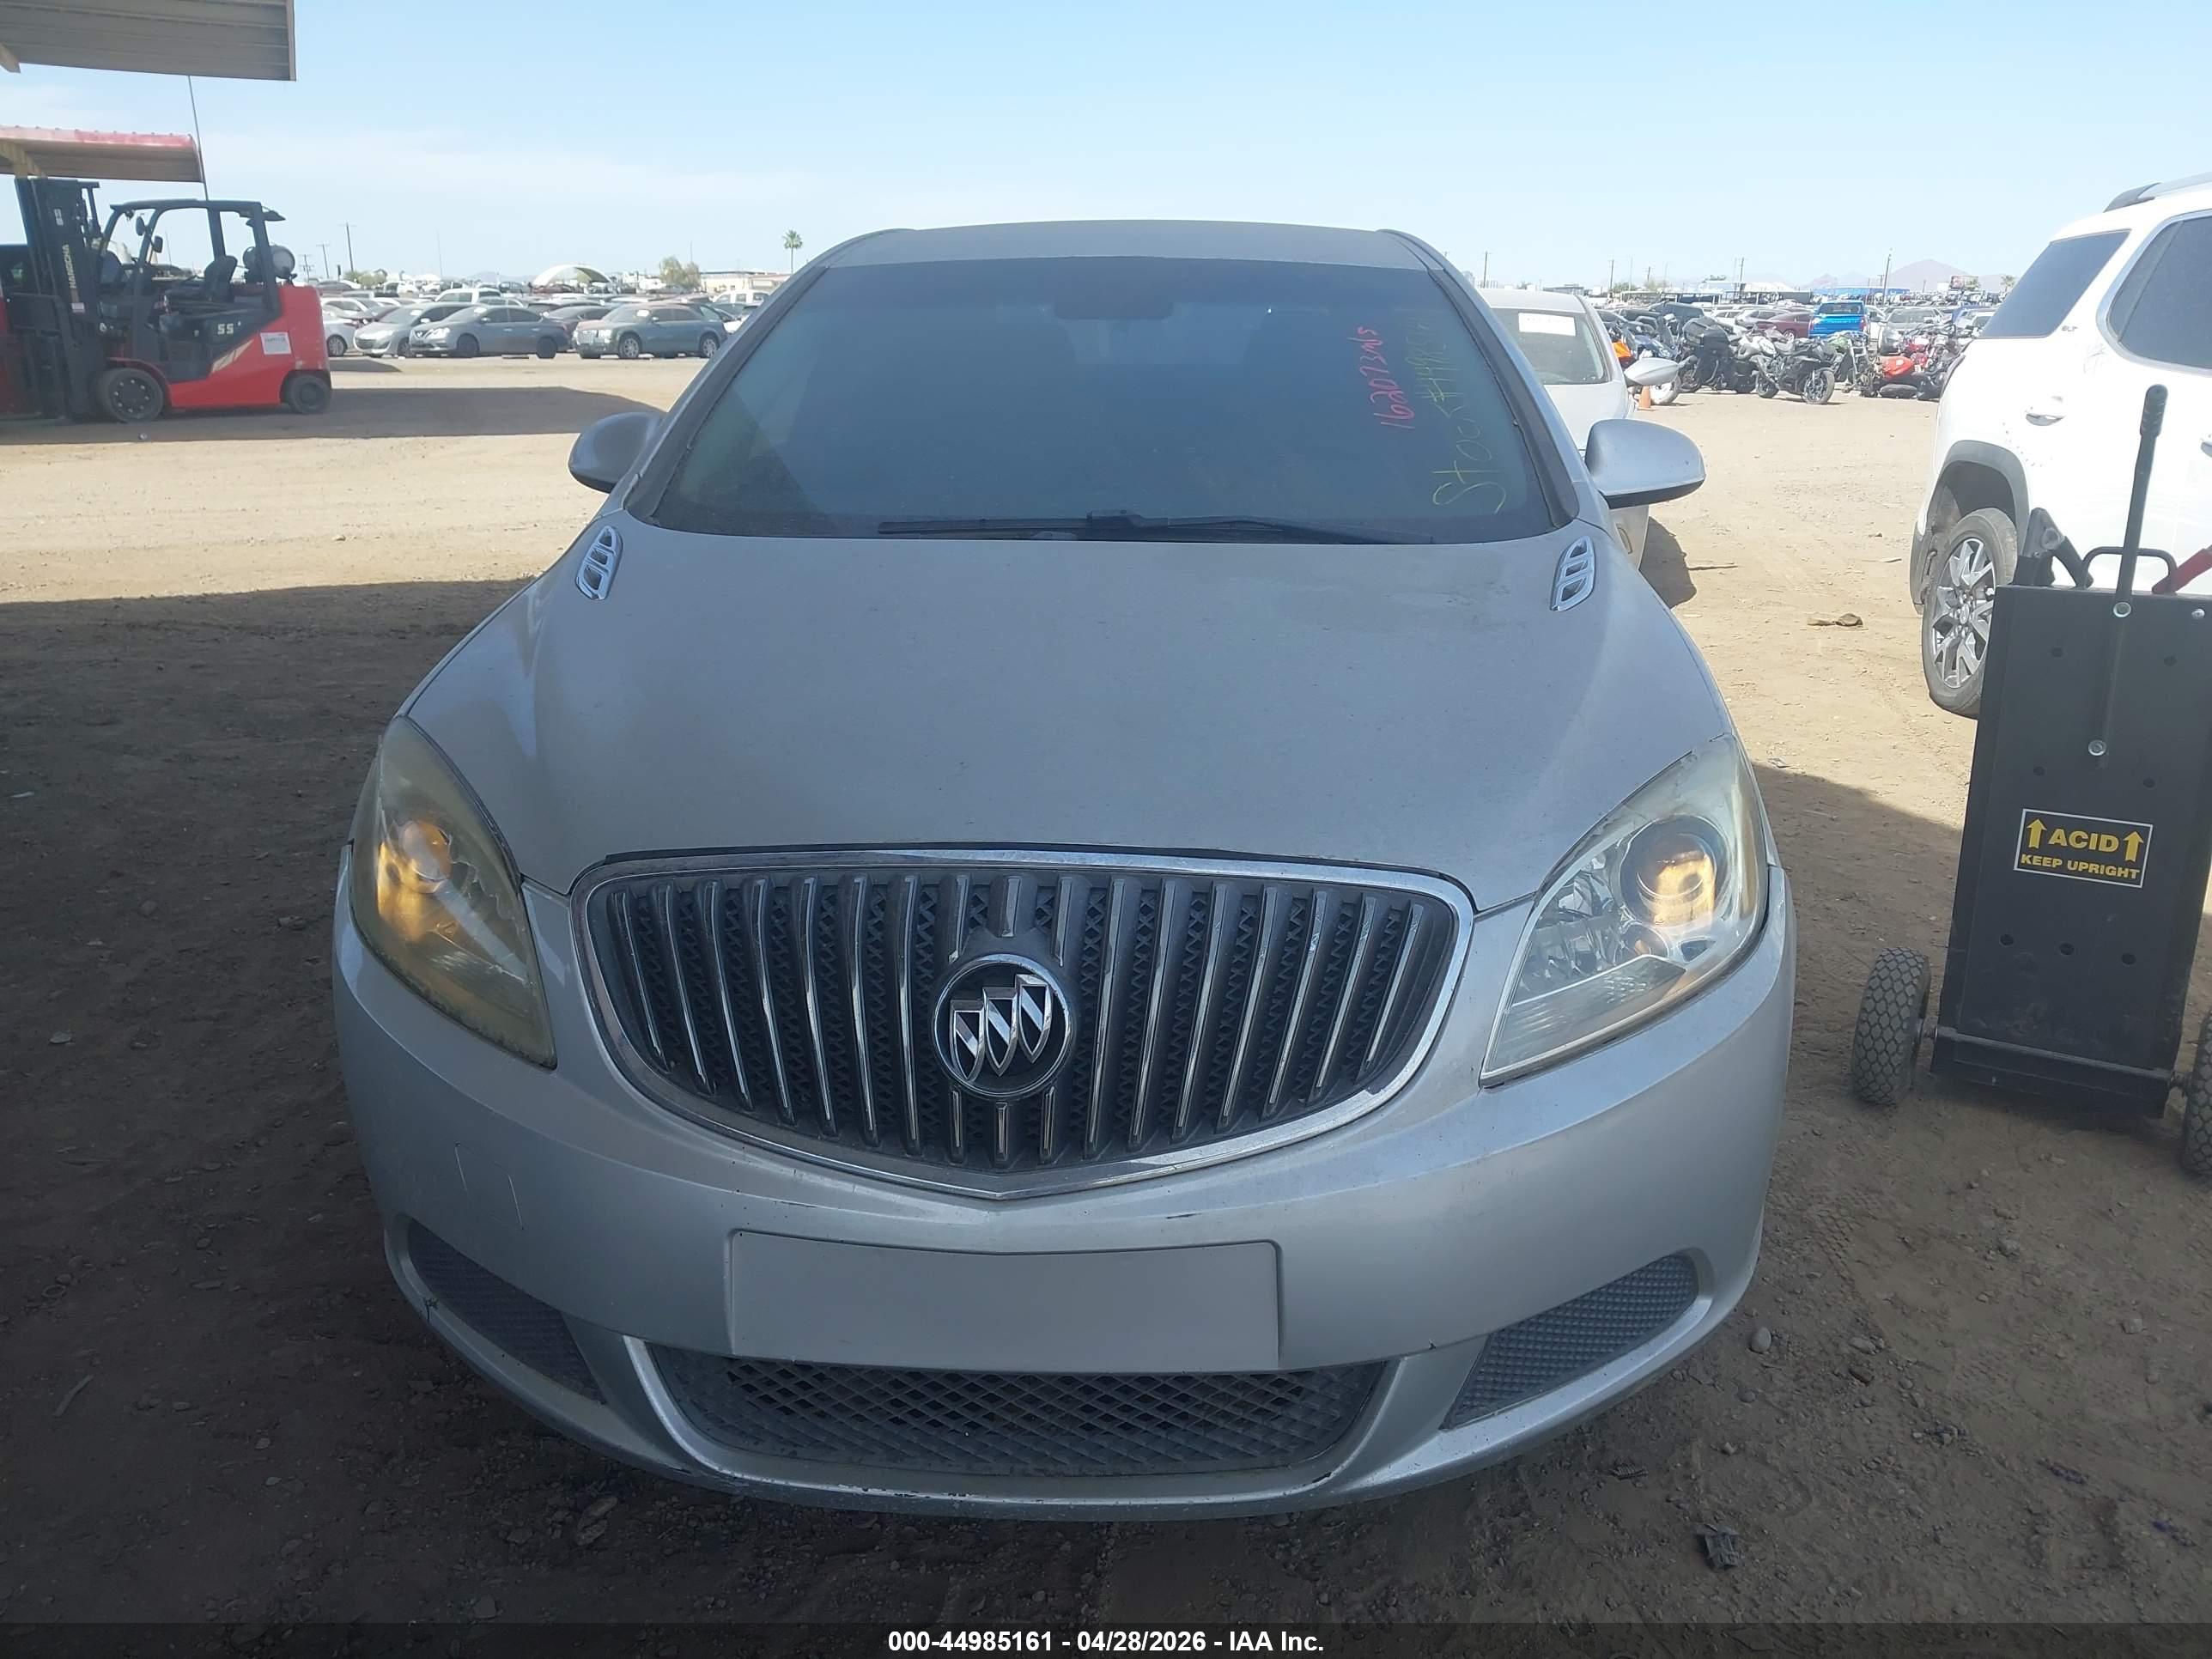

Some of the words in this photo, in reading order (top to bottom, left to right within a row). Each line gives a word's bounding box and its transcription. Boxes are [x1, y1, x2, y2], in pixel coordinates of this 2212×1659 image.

[2048, 828, 2119, 853] ACID
[2021, 854, 2063, 868] KEEP
[2067, 860, 2141, 879] UPRIGHT
